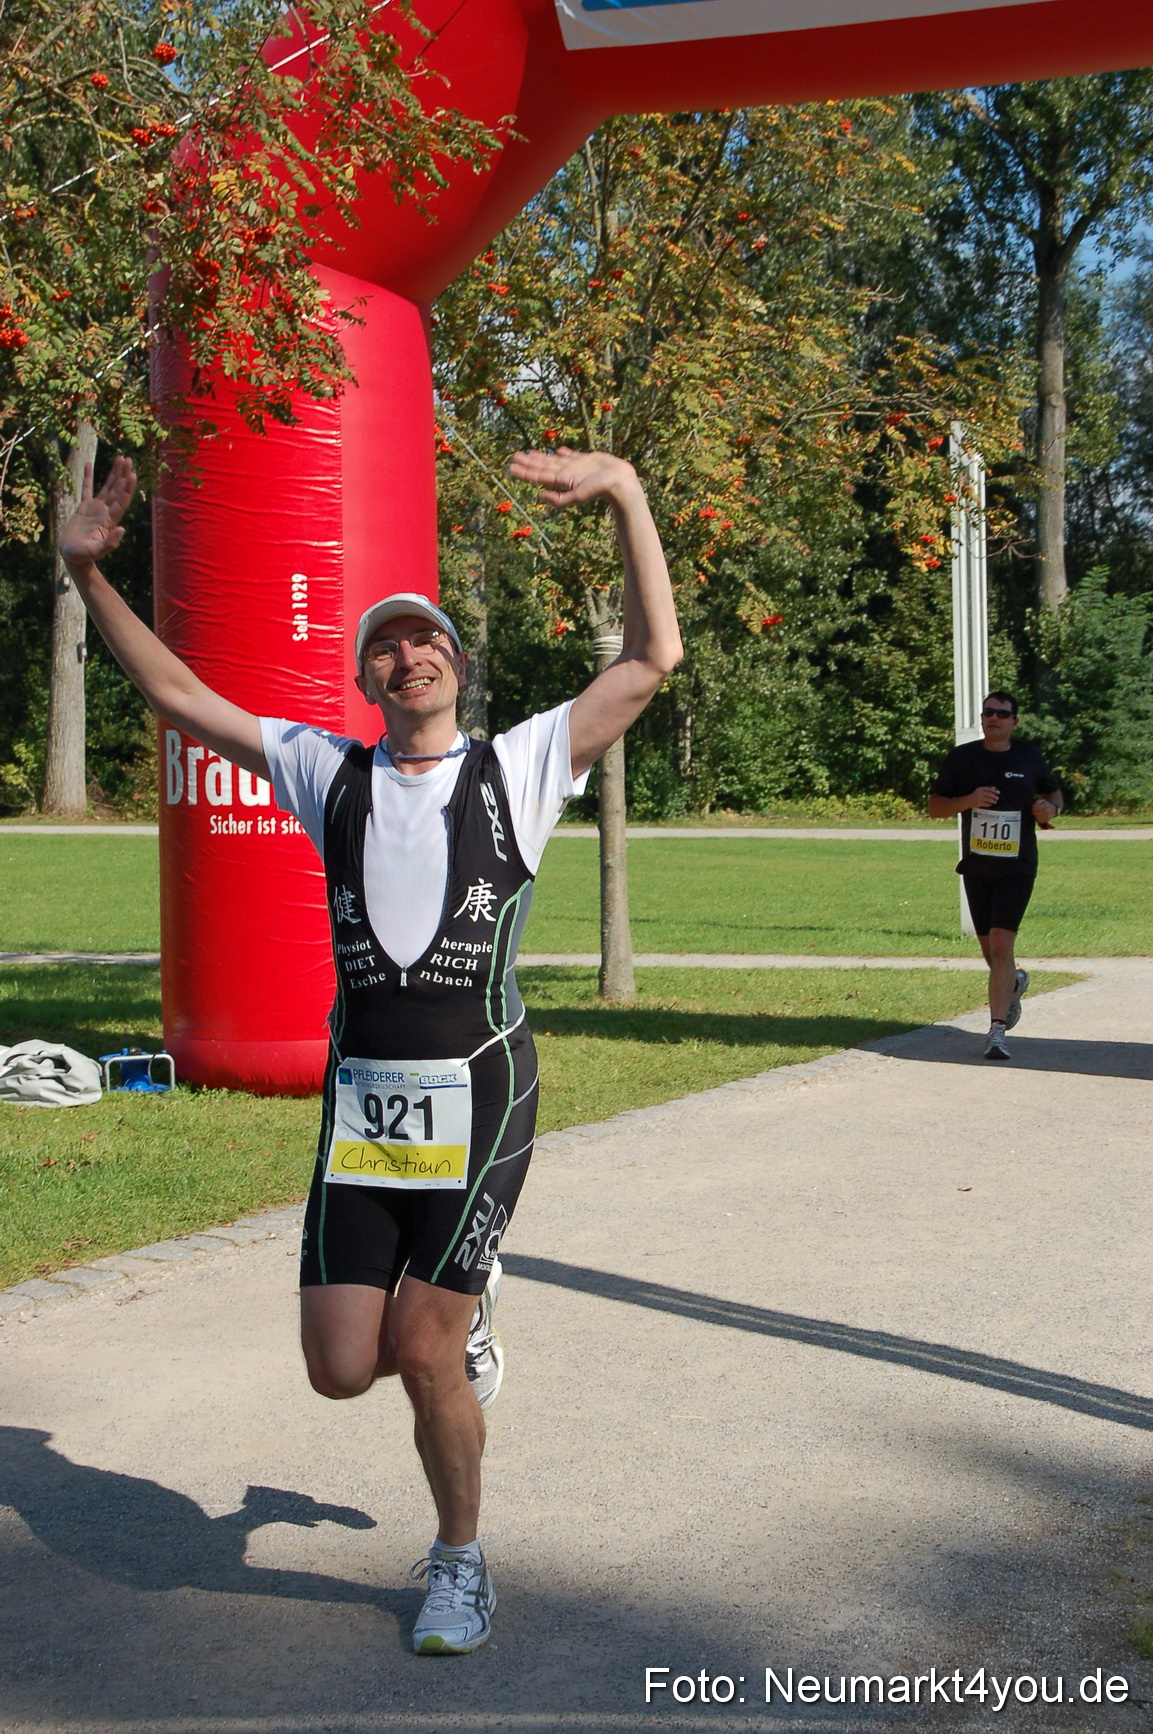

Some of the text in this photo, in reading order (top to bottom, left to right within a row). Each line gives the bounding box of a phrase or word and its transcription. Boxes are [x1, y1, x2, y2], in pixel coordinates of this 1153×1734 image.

[291, 573, 309, 641] Seit 1929
[210, 813, 253, 835] Sicher
[257, 815, 276, 835] ist
[479, 782, 508, 863] 2XU
[980, 821, 1011, 840] 110
[976, 839, 1012, 852] Roberto
[453, 877, 498, 922] 康
[337, 936, 493, 956] Physiot herapie
[345, 952, 479, 972] DIET RICH
[350, 970, 473, 989] Esche nbach
[353, 1069, 405, 1083] PFLEIDERER
[364, 1093, 434, 1141] 921
[341, 1147, 451, 1174] Christian
[454, 1192, 495, 1271] 2XU
